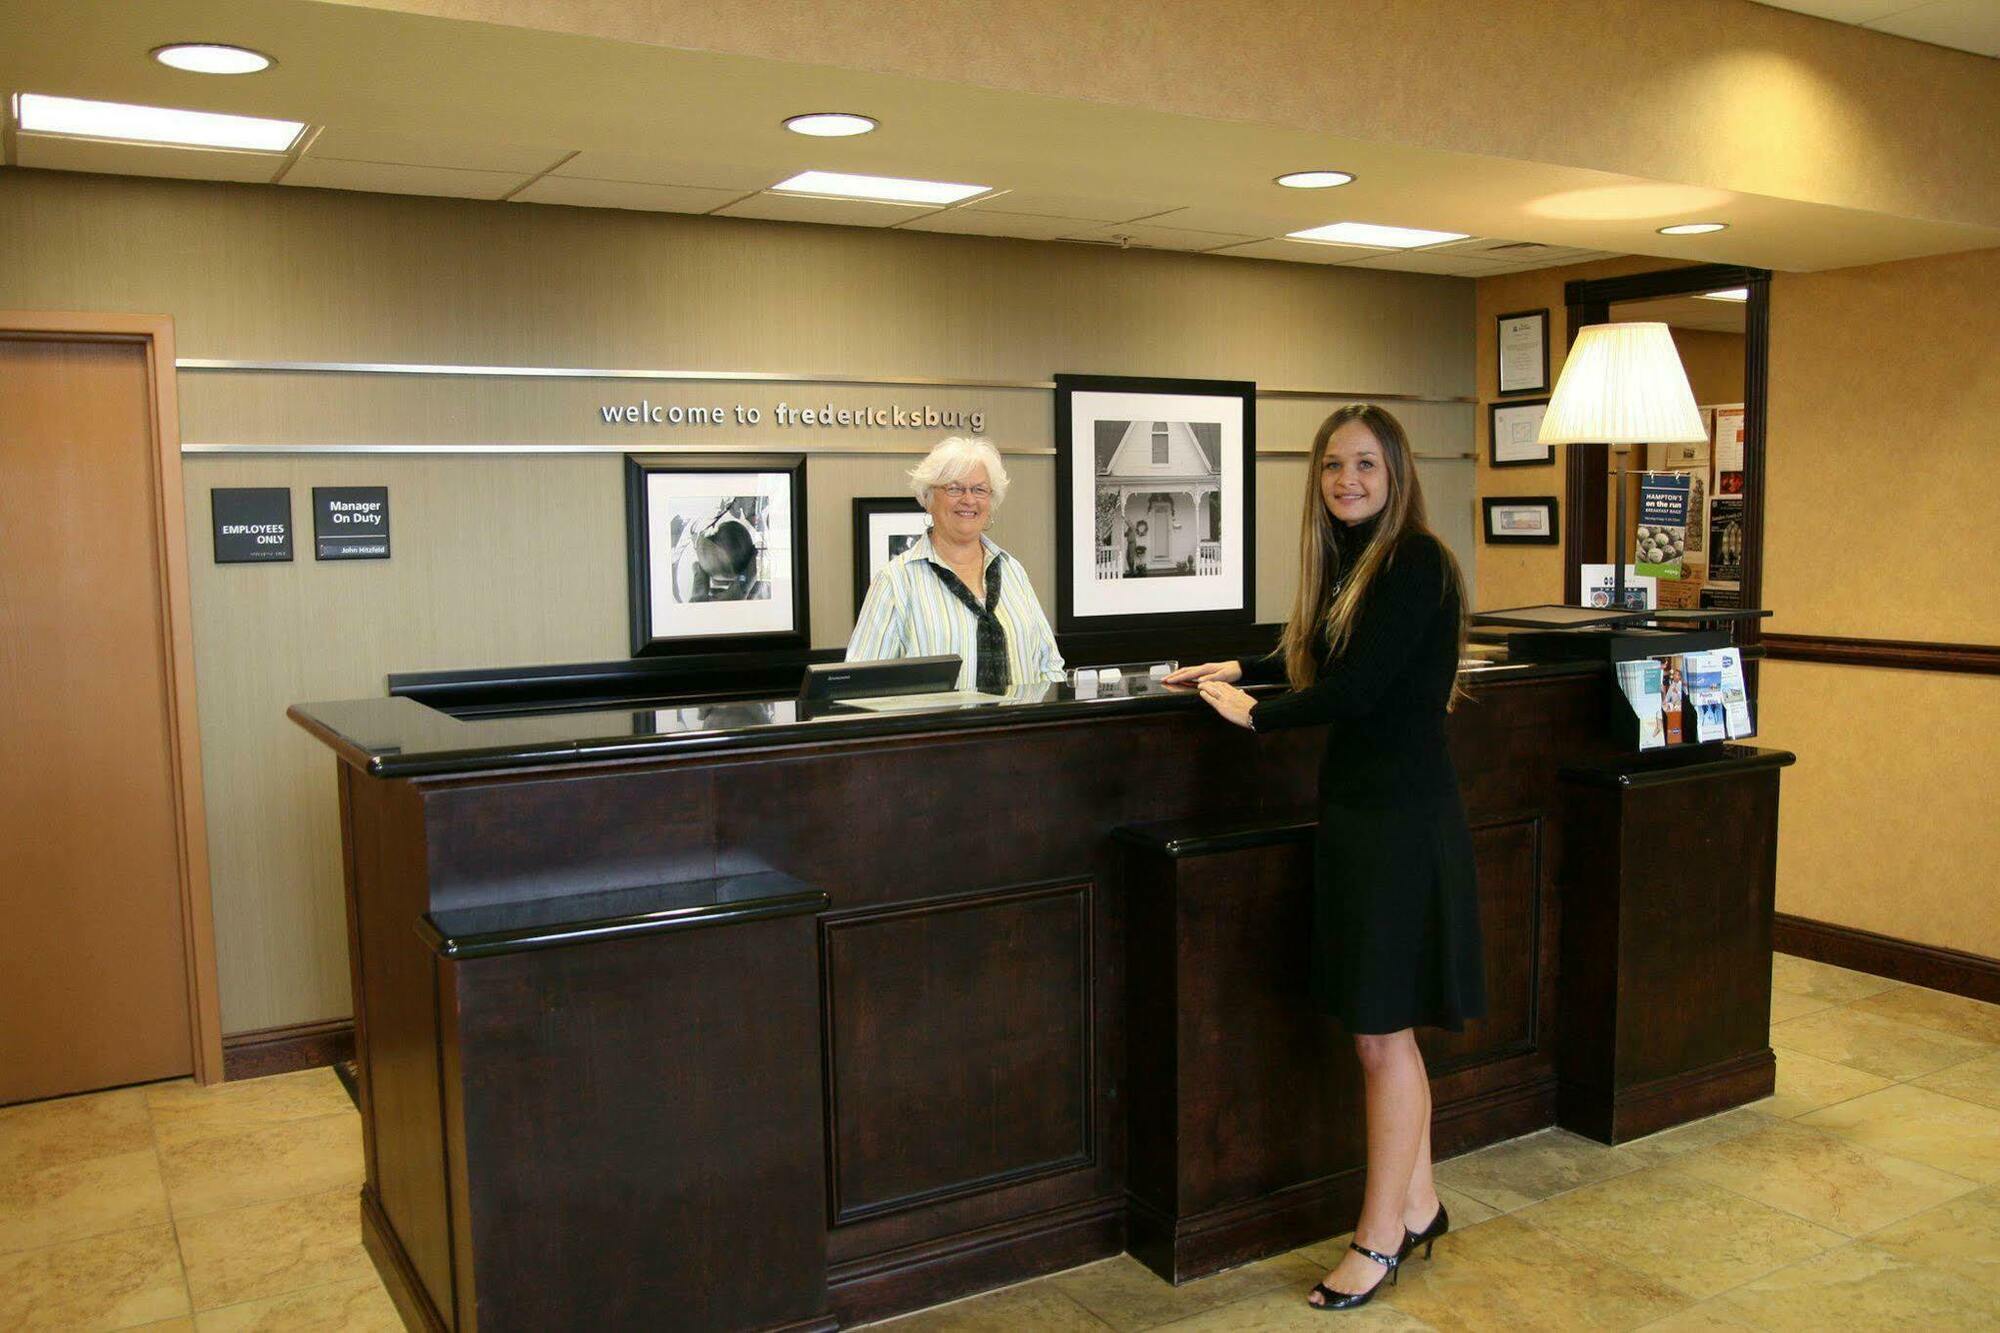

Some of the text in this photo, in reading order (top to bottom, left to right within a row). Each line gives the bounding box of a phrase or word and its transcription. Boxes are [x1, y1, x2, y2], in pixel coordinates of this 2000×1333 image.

[601, 400, 985, 433] welcome to fredericksburg
[330, 501, 381, 513] Manager
[333, 513, 382, 526] On Duty
[222, 525, 285, 535] EMPLOYEES
[257, 535, 285, 545] ONLY
[341, 546, 358, 554] John
